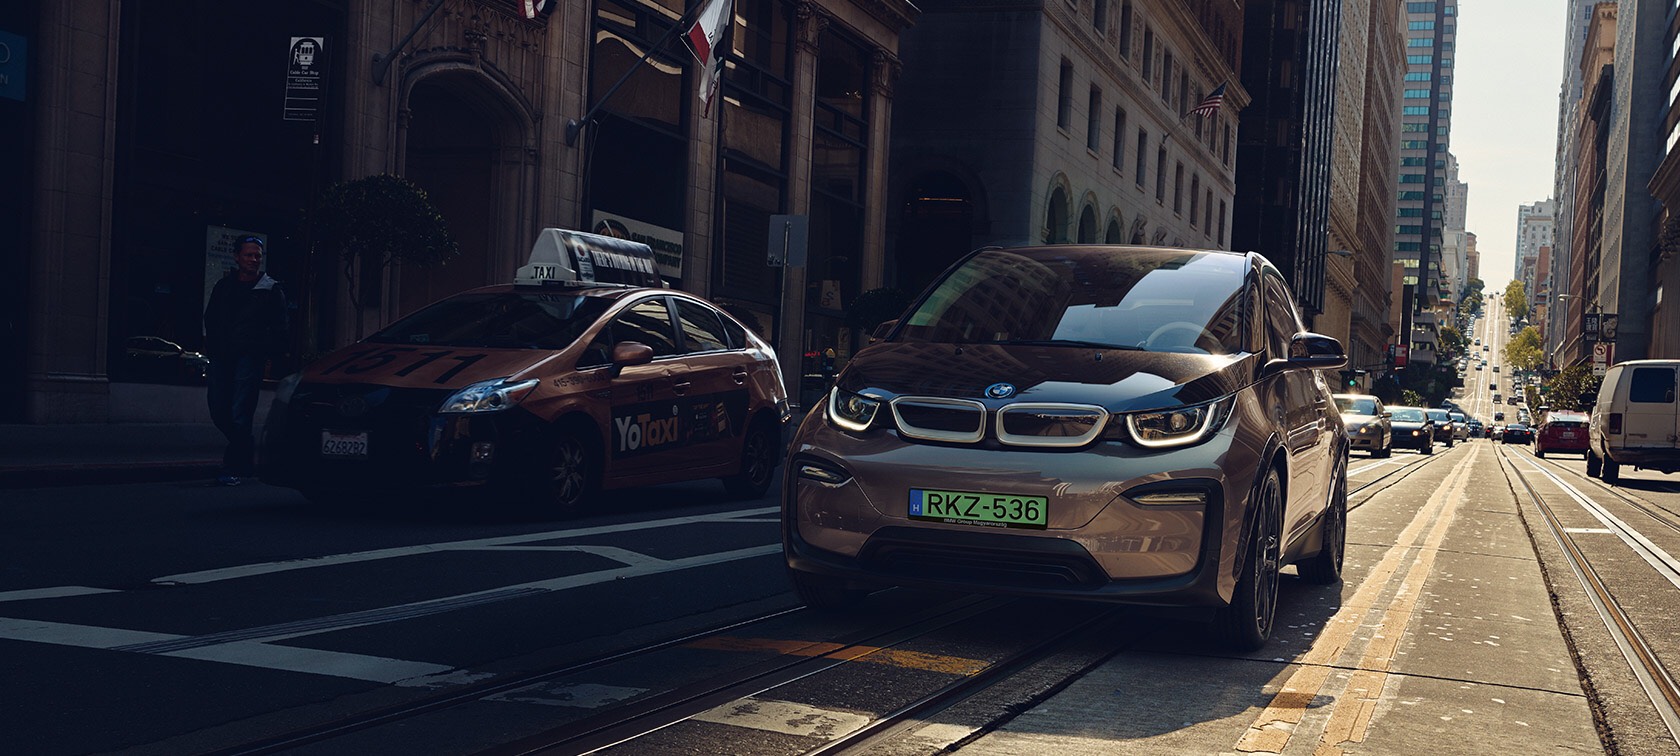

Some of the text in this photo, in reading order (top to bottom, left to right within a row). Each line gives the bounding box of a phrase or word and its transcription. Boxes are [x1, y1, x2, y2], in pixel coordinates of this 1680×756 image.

[533, 266, 556, 279] TAXI
[614, 404, 680, 452] YoTaxi
[912, 493, 1039, 521] H RKZ-536
